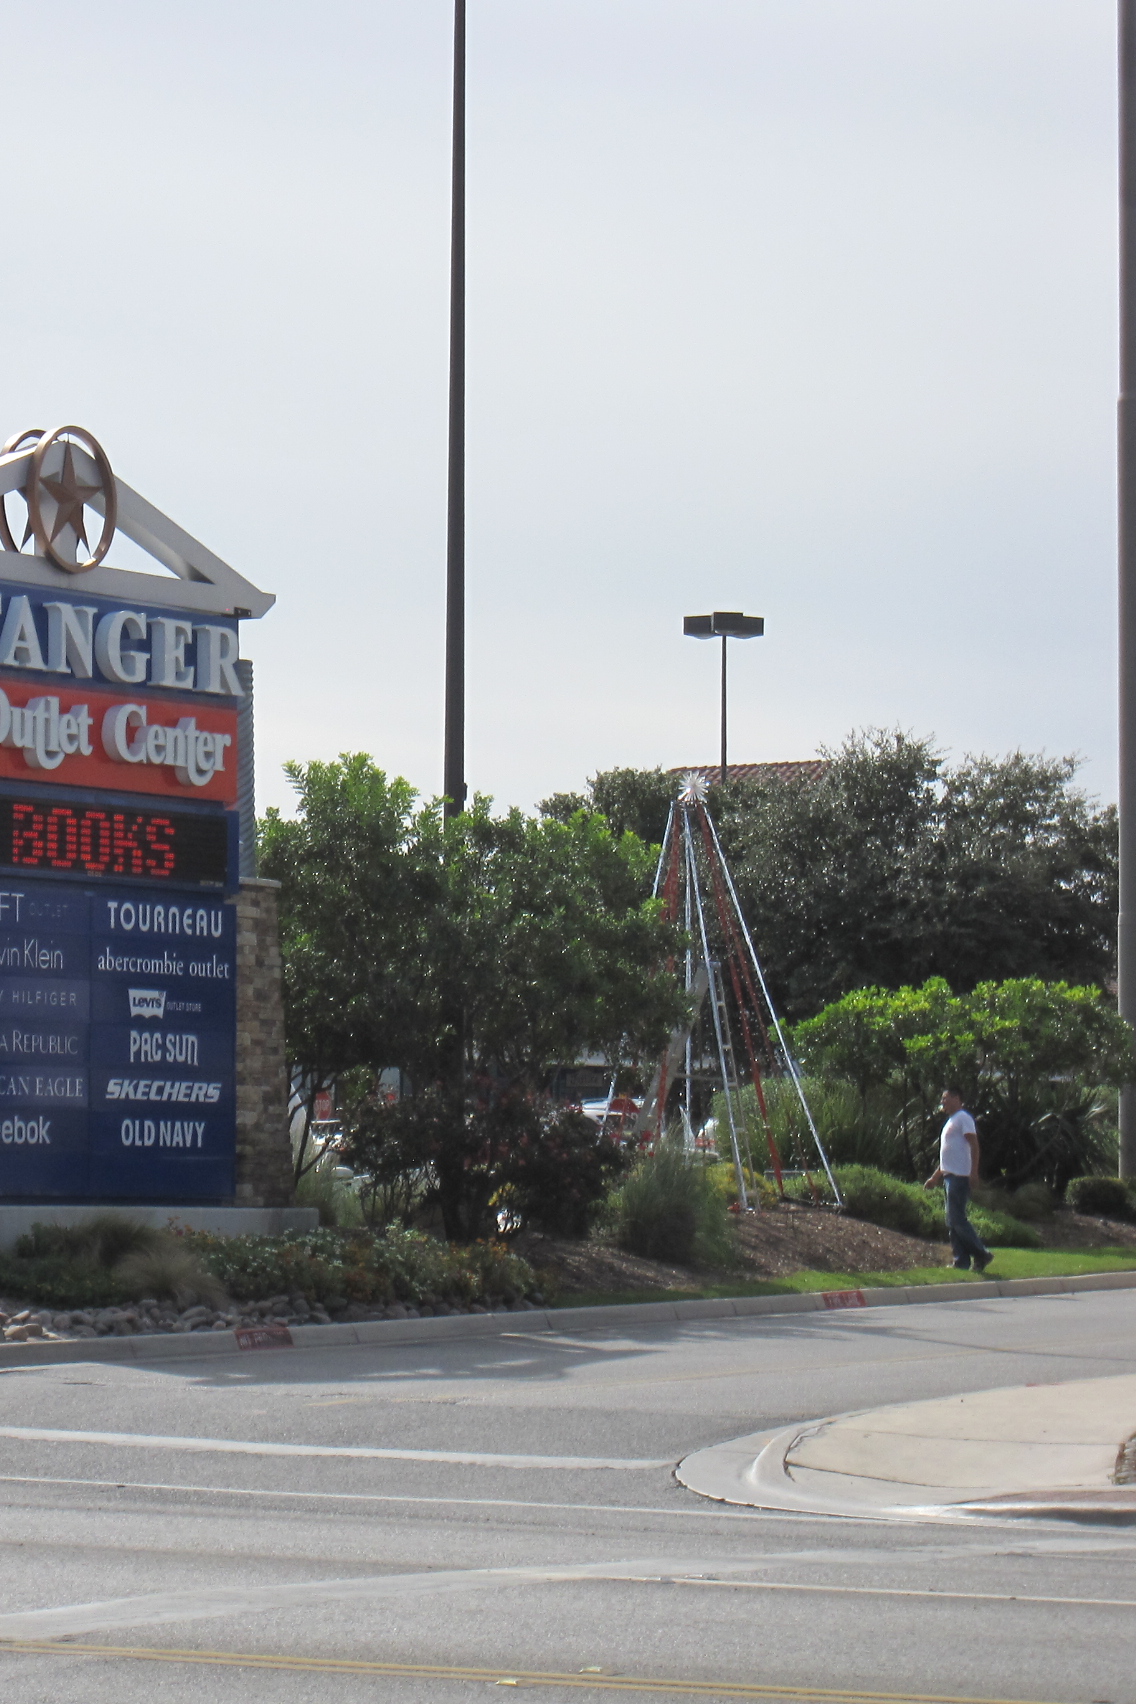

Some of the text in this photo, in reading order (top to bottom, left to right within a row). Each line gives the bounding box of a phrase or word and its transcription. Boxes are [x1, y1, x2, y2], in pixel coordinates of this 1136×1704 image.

[101, 704, 232, 787] Center
[13, 804, 175, 876] BOOKS
[107, 901, 222, 938] TOURNEAU
[24, 938, 64, 969] Klein
[97, 947, 230, 979] abercrombie outlet
[12, 990, 77, 1006] HILFIGER
[166, 1001, 184, 1011] OUTLET
[185, 1002, 202, 1012] STORE
[12, 1029, 79, 1055] REPUBLIC
[130, 1030, 162, 1063] PAC
[36, 1077, 83, 1098] EAGLE
[105, 1078, 222, 1103] SKECHERS
[121, 1119, 205, 1148] OLD NAVY
